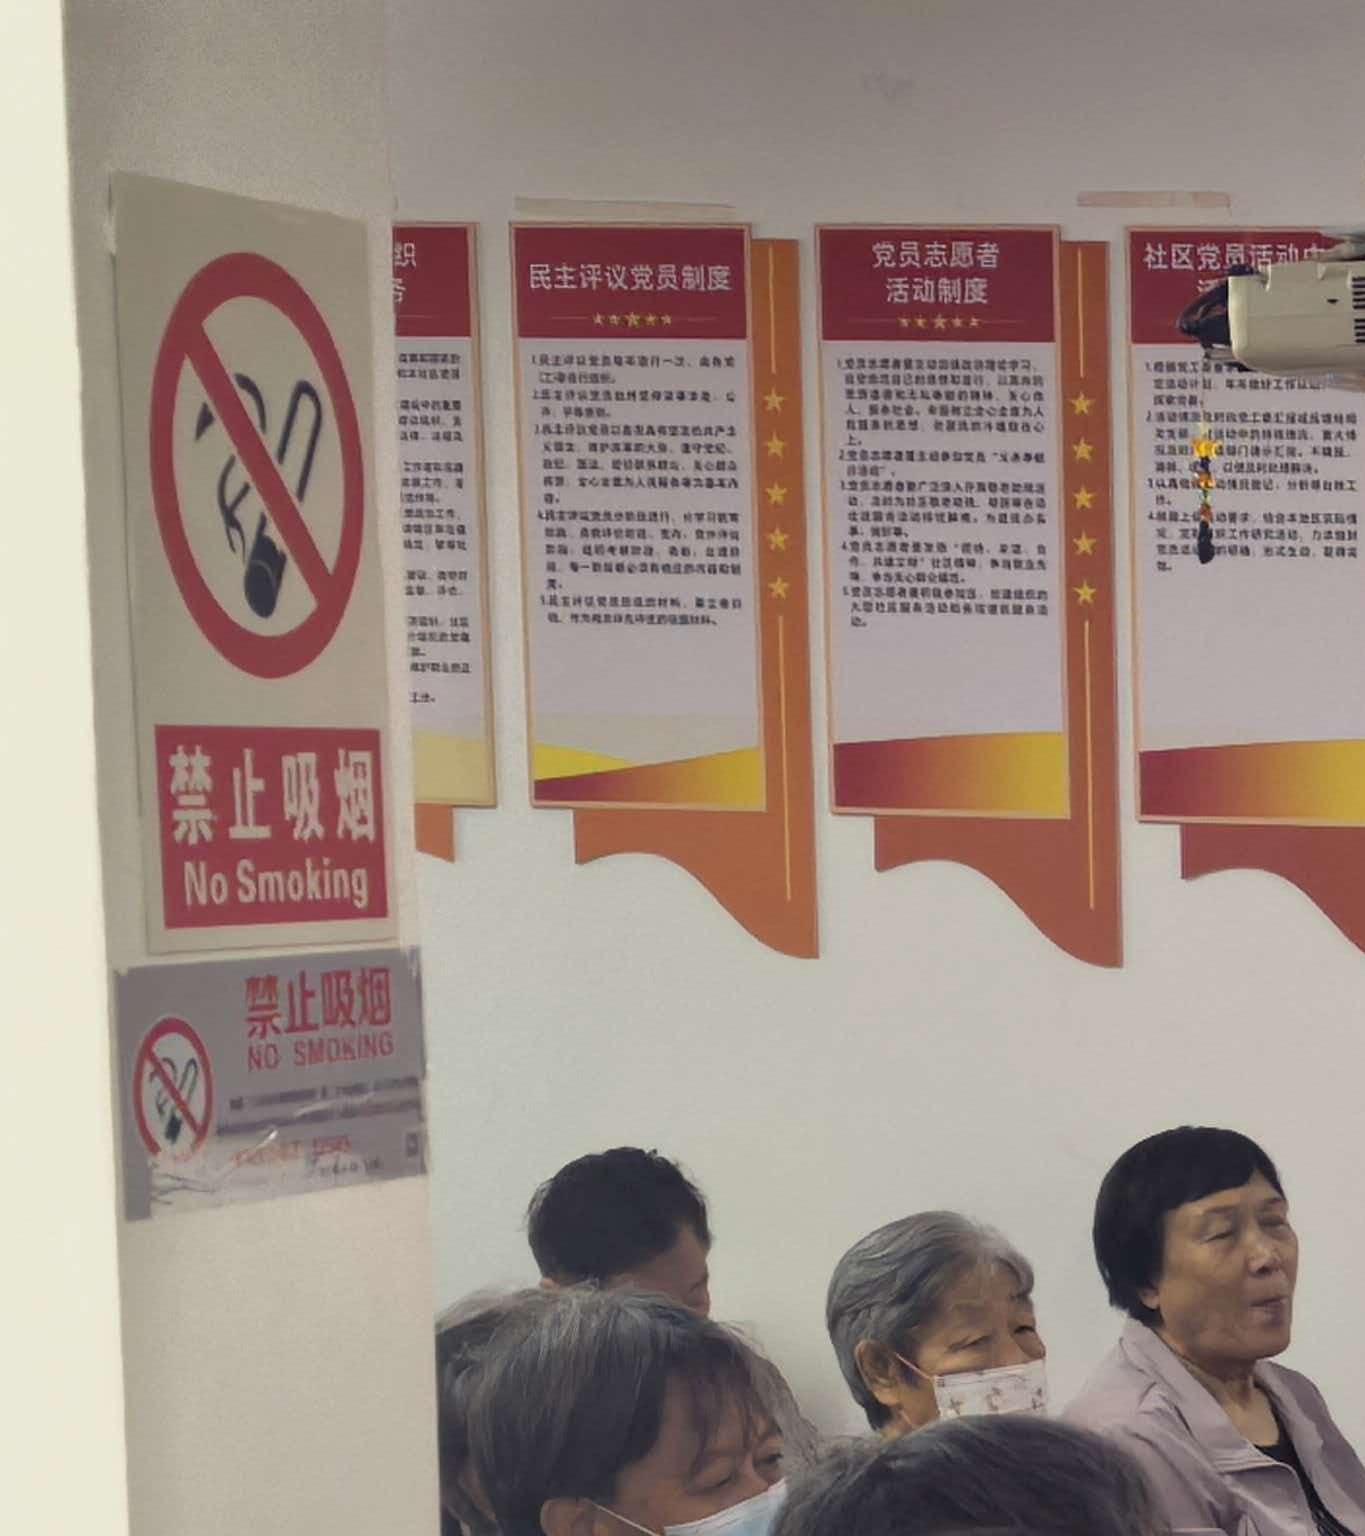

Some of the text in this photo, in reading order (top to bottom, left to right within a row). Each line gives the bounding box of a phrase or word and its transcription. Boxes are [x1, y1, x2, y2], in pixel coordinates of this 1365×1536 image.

[872, 241, 1000, 269] 党员志愿者
[529, 262, 732, 291] 民主评议党员制度
[886, 277, 988, 304] 活动制度
[168, 744, 376, 846] 禁止吸烟
[183, 857, 369, 909] No Smoking
[244, 965, 392, 1040] 禁止吸烟
[247, 1032, 394, 1072] NO SMOKING
